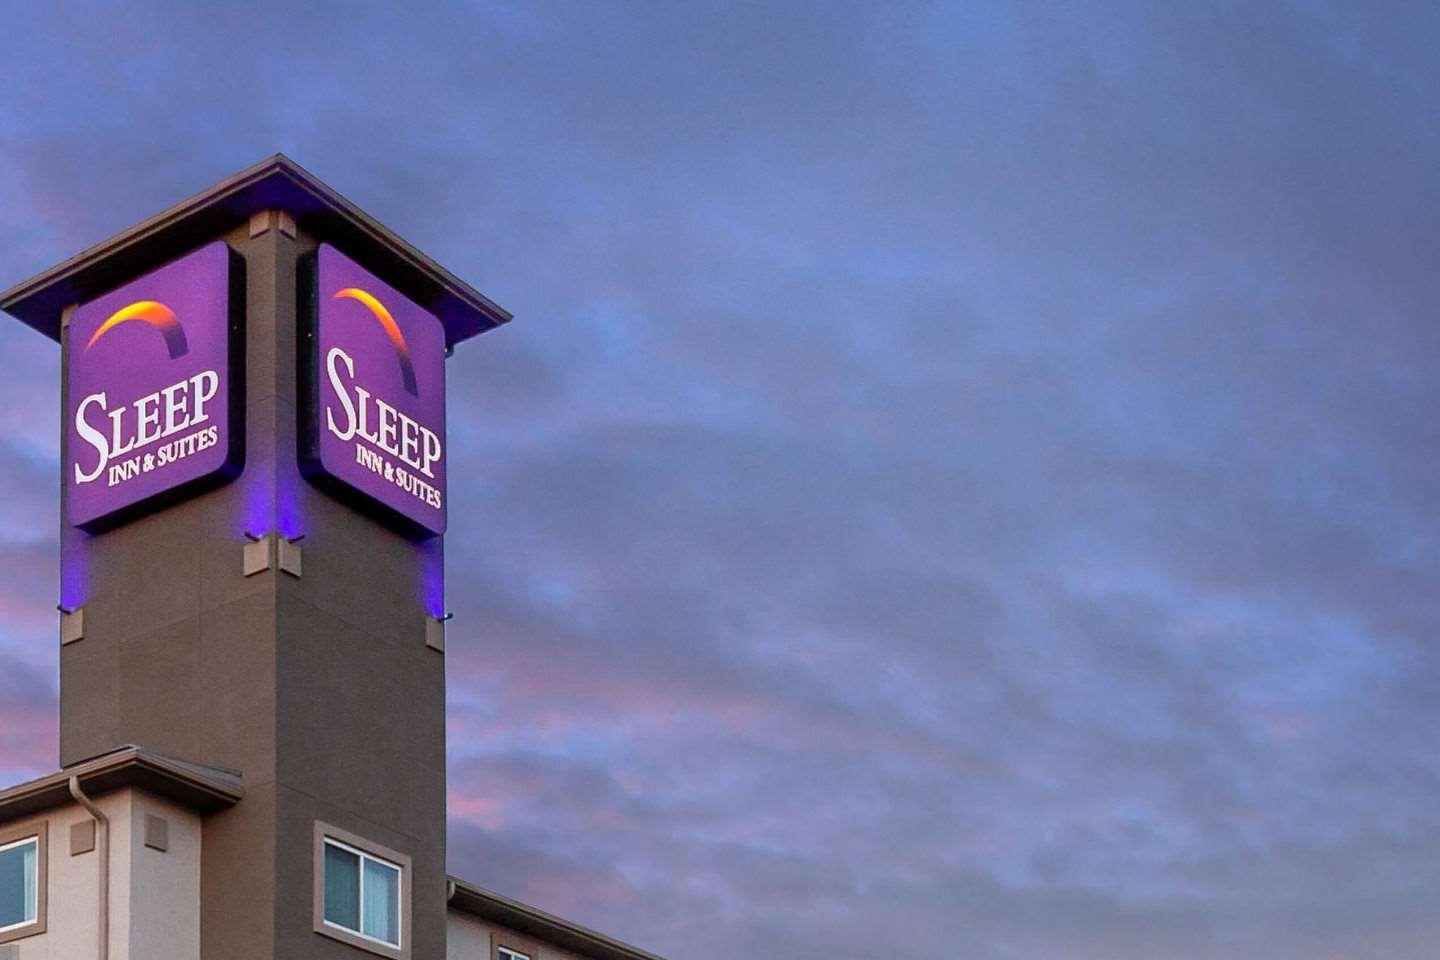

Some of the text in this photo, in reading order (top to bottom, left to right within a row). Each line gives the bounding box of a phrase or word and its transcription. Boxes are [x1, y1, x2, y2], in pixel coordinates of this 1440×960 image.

[75, 370, 219, 484] SLEEP
[108, 425, 218, 487] INN & SUITES
[326, 347, 441, 479] SLEEP
[356, 443, 441, 509] INN & SUITES
